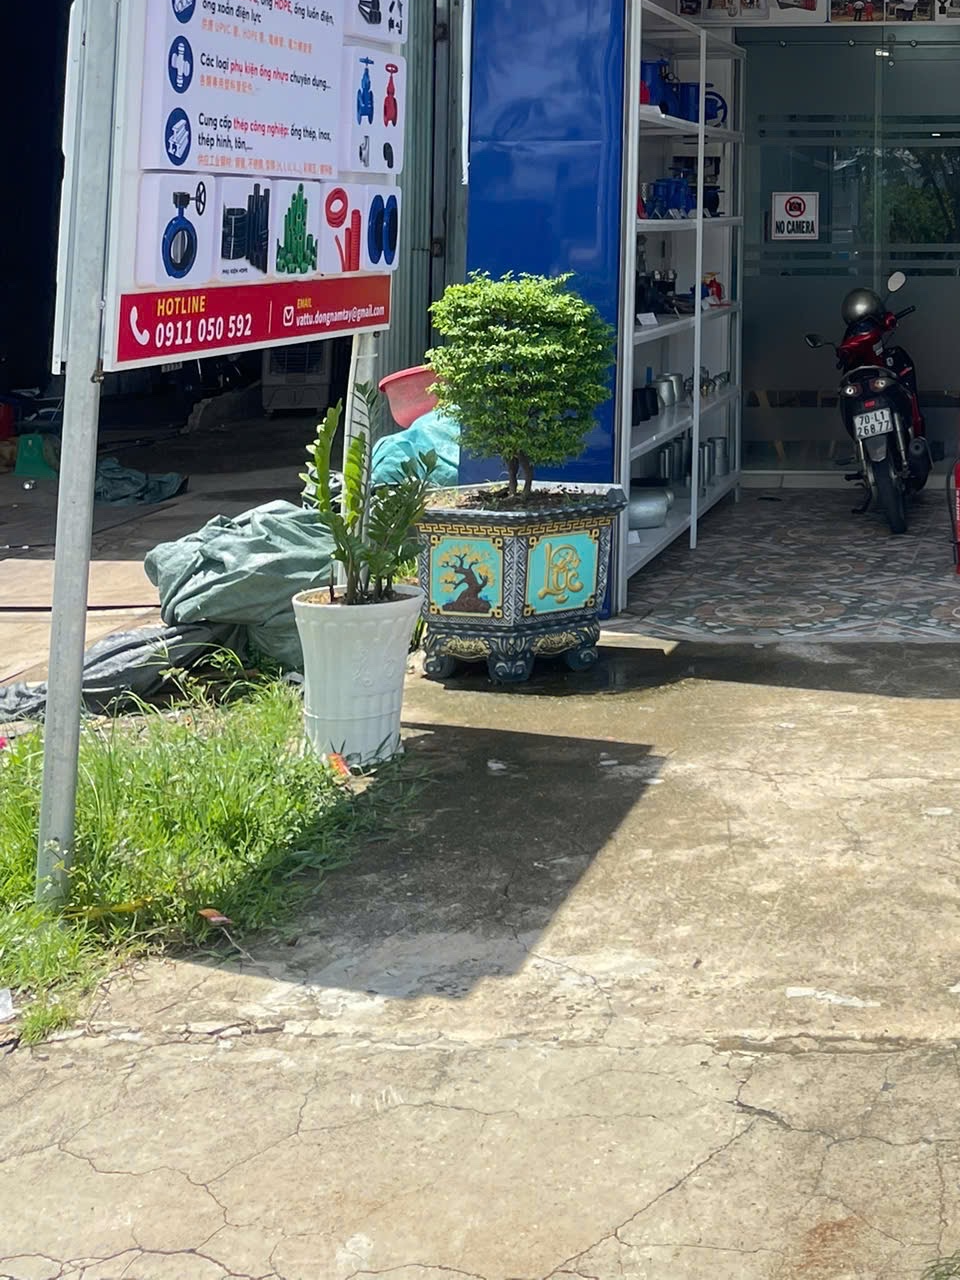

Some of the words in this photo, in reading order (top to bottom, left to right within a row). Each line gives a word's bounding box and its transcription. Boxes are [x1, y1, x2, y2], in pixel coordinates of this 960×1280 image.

[775, 221, 785, 234] NO
[787, 220, 815, 235] CAMERA
[157, 296, 206, 317] HOTLINE
[297, 298, 312, 308] EMAIL
[155, 319, 192, 348] 0911
[198, 316, 224, 342] 050
[228, 313, 252, 338] 592
